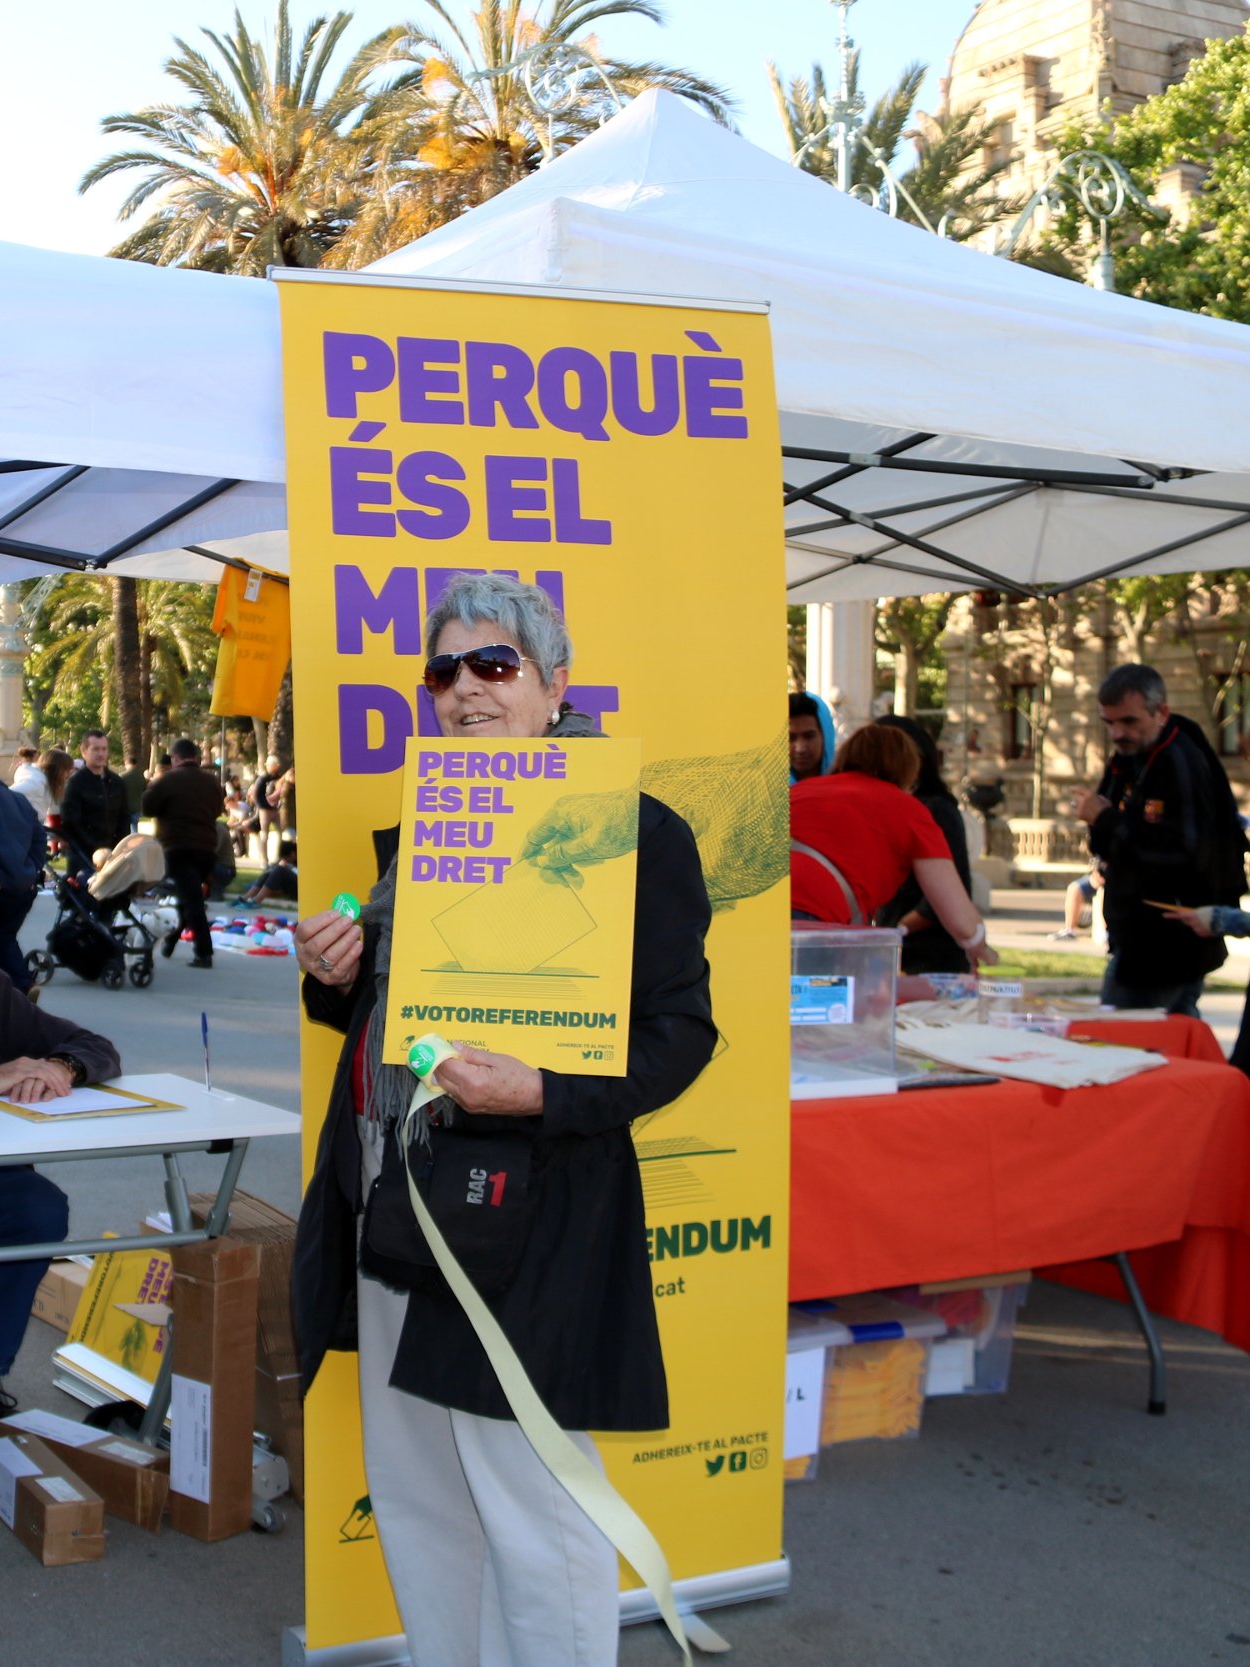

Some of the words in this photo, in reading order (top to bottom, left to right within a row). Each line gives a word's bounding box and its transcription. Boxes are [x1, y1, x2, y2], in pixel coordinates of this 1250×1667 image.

[323, 330, 749, 441] PERQUÈ
[329, 421, 471, 540] ÉS
[485, 455, 613, 545] EL
[417, 743, 567, 781] PERQUÈ
[415, 778, 463, 813] ÉS
[468, 787, 514, 814] EL
[413, 821, 493, 849] MEU
[411, 855, 512, 884] DRET
[400, 1004, 618, 1030] #VOTOREFERENDUM
[466, 1168, 487, 1205] RAC
[488, 1170, 507, 1207] 1
[632, 1439, 711, 1464] ADHEREIX-TE
[712, 1438, 729, 1450] AL
[730, 1431, 768, 1447] PACTE
